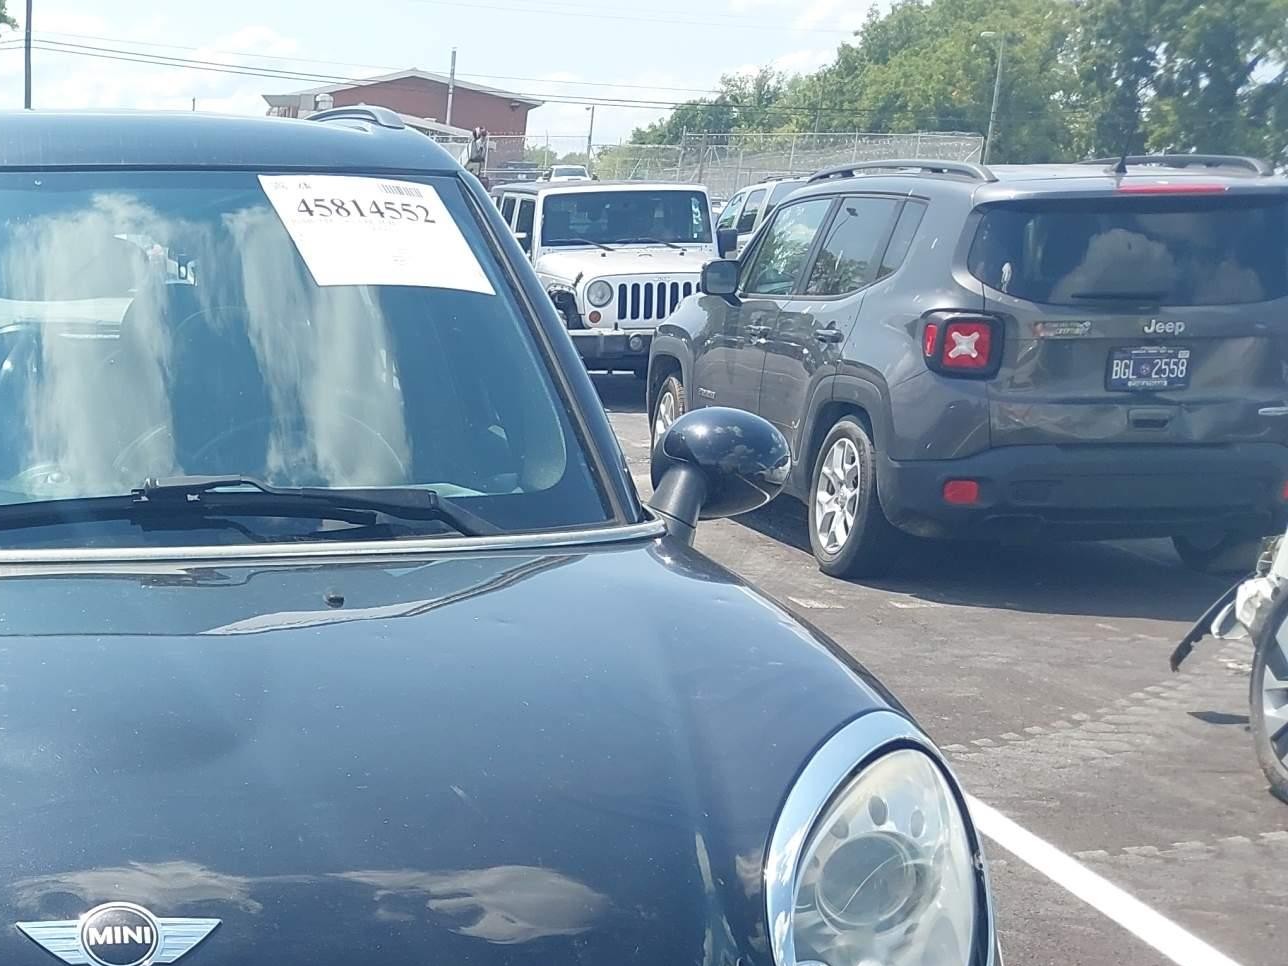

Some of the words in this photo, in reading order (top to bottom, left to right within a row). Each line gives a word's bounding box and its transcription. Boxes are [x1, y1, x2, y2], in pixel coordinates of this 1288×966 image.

[296, 198, 436, 224] 45814552
[1143, 319, 1185, 335] Jeep
[1112, 359, 1137, 379] BGL
[1151, 358, 1187, 378] 2558
[88, 925, 151, 946] MINI
